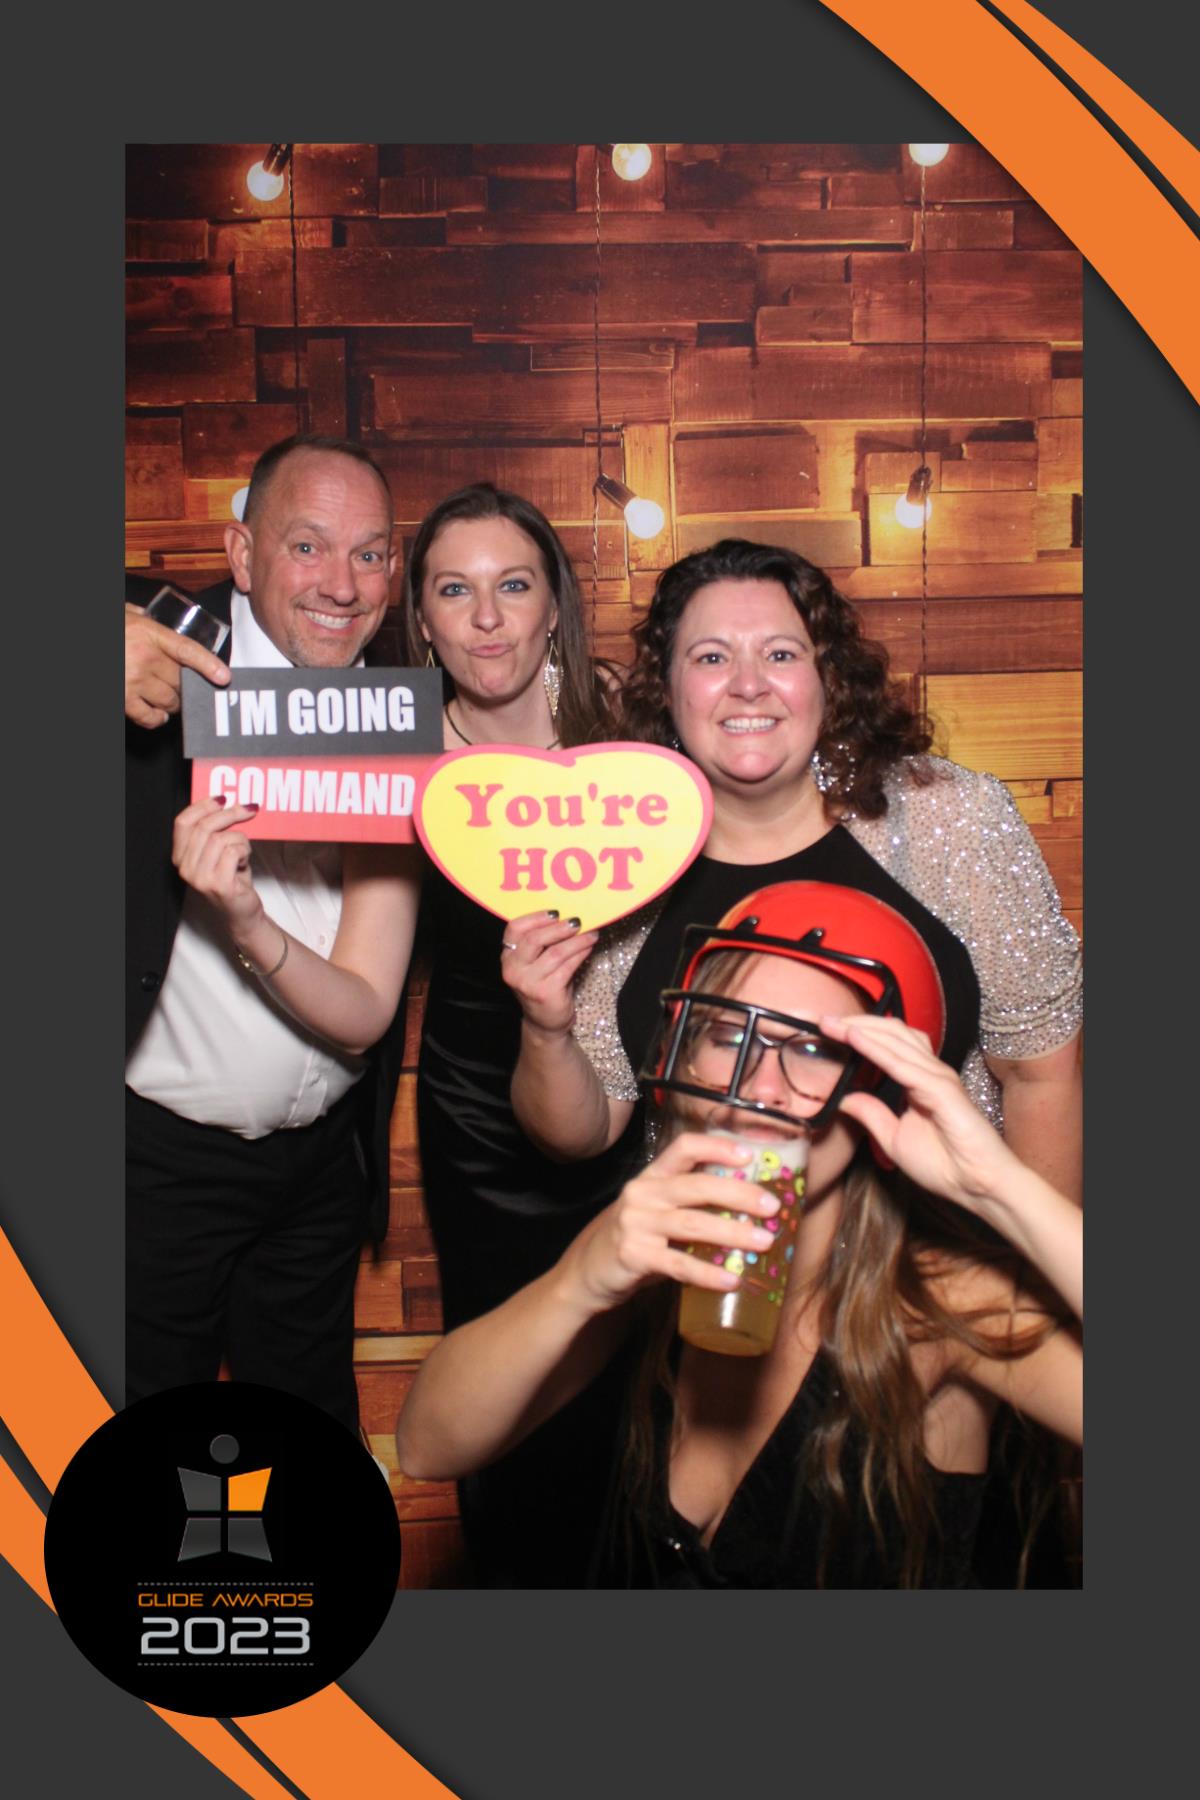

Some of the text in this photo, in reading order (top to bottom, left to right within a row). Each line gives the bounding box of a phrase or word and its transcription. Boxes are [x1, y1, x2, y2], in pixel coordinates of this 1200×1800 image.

[214, 686, 415, 737] I'M GOING
[209, 765, 415, 817] COMMAND
[455, 783, 669, 828] You're
[499, 847, 644, 892] HOT
